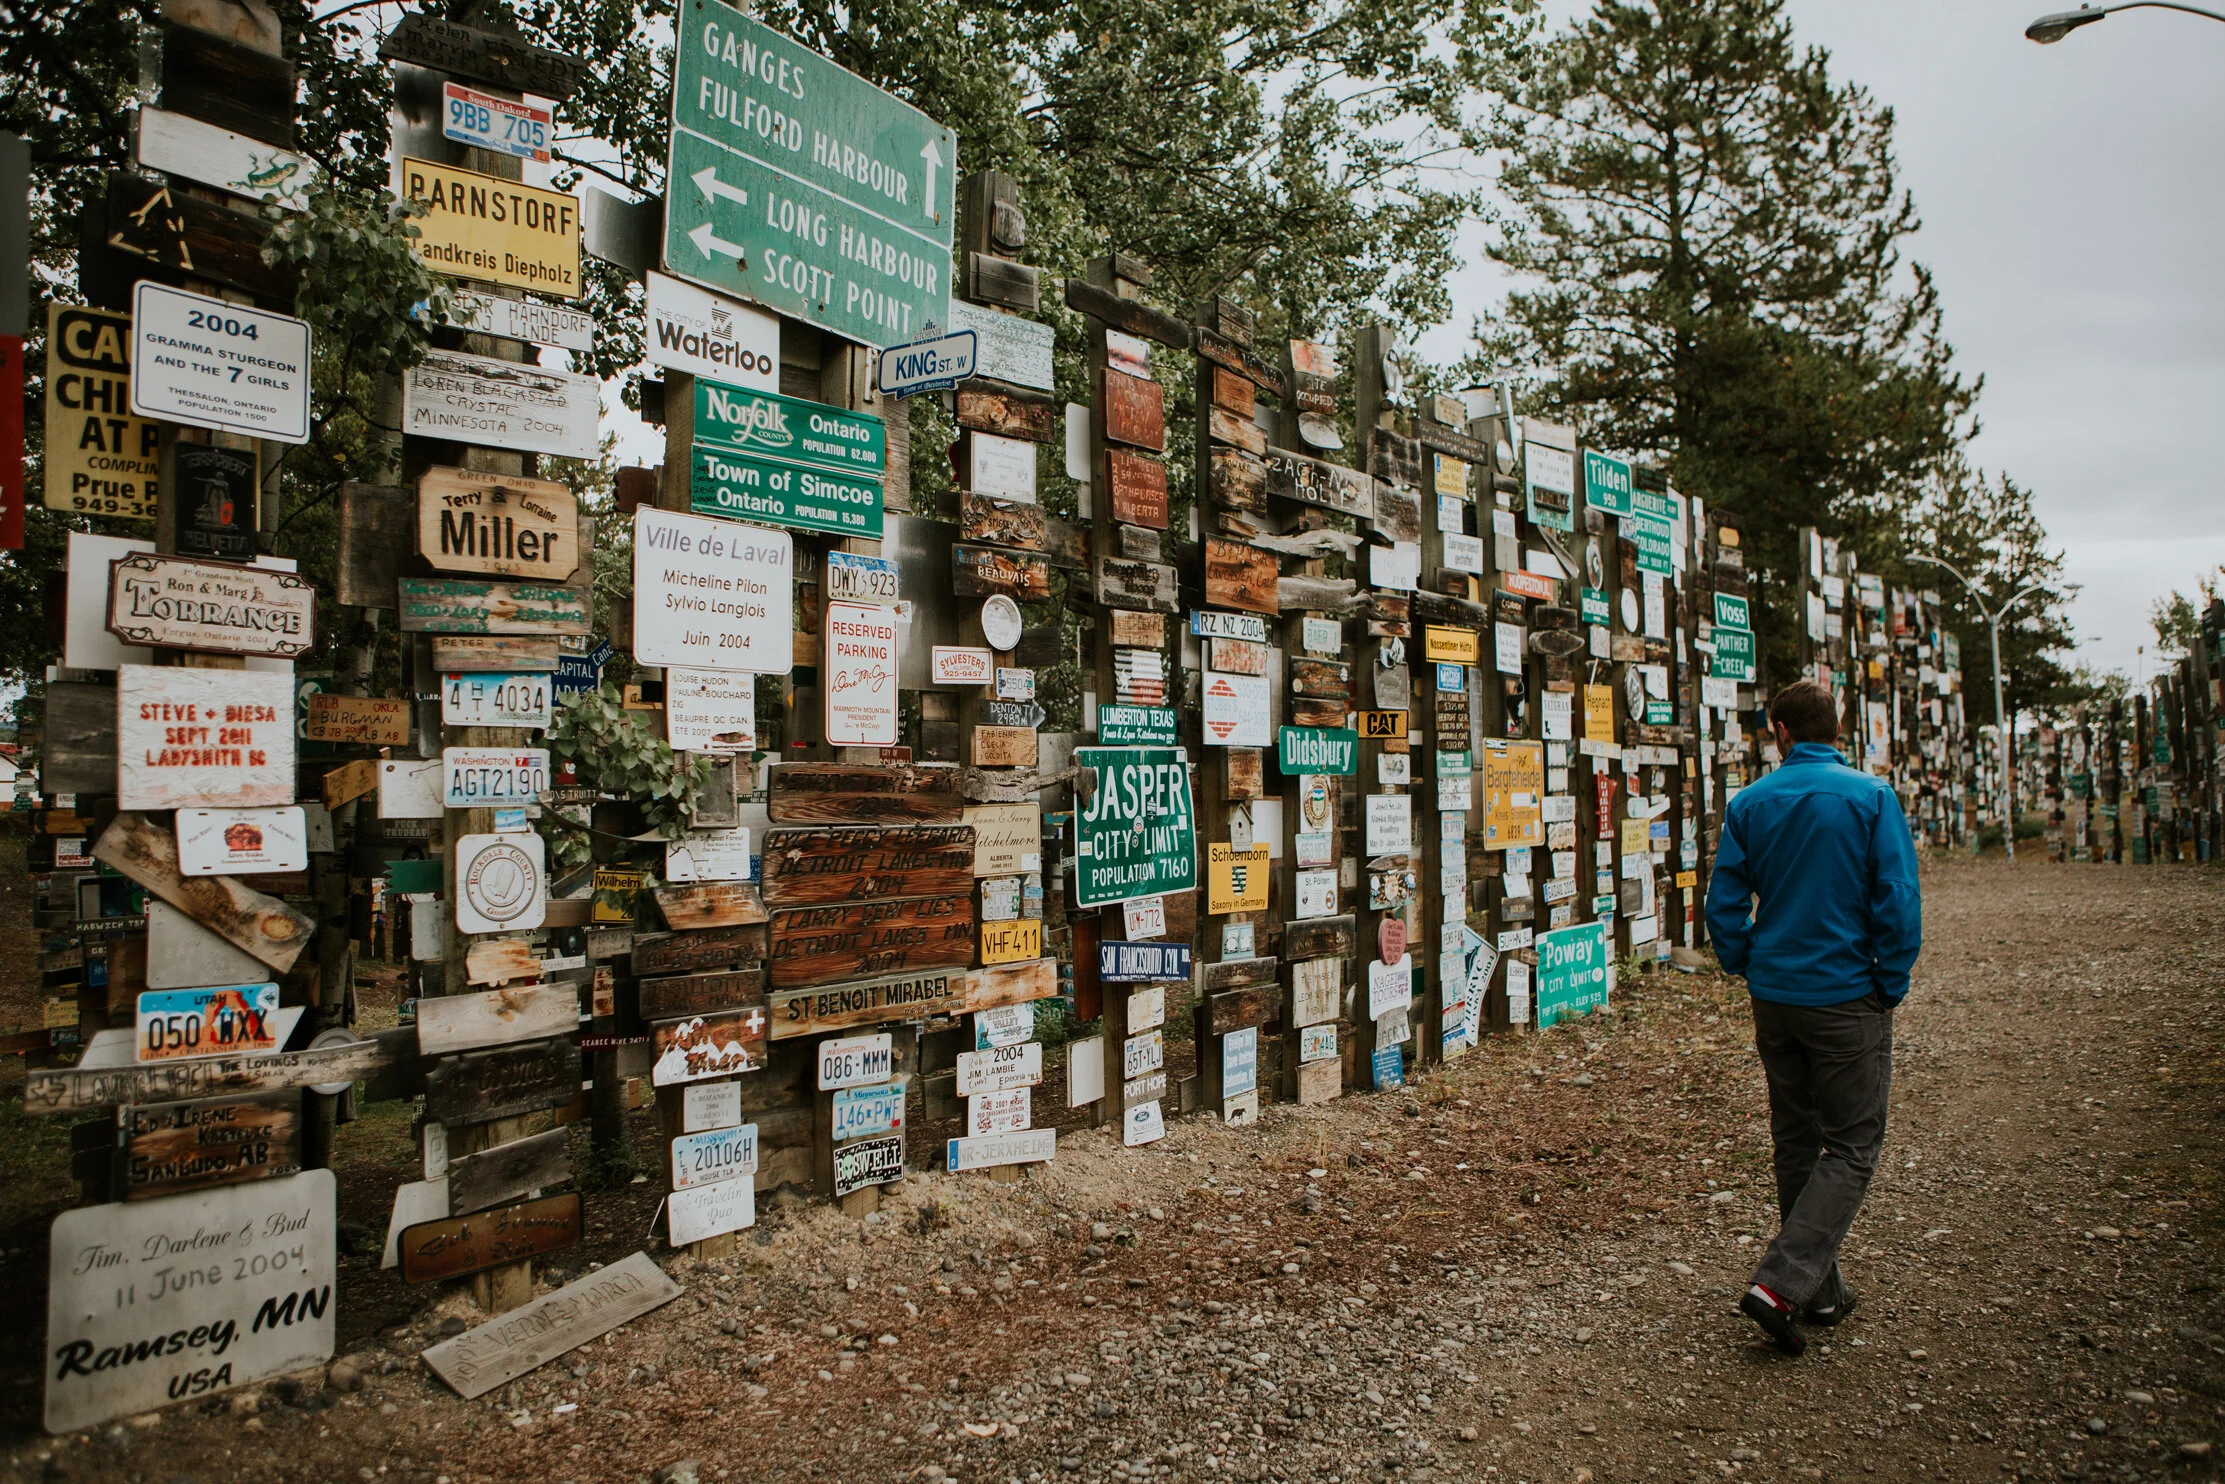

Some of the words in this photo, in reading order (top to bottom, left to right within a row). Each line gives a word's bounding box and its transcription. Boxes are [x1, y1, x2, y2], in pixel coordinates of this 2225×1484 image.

[704, 22, 805, 99] GANGES
[468, 94, 495, 112] South
[496, 102, 531, 118] Dakota
[504, 115, 544, 147] 705
[699, 76, 802, 151] FULFORD
[812, 131, 907, 206] HARBOUR
[767, 192, 826, 247] LONG
[840, 224, 937, 296] HARBOUR
[505, 252, 572, 285] Diepholz
[764, 248, 834, 305] SCOTT
[846, 281, 912, 334] POINT
[188, 310, 259, 341] 2004
[508, 302, 589, 333] HAHNDORF
[656, 307, 673, 320] THE
[509, 320, 560, 344] LINDE
[146, 333, 213, 356] GRAMMA
[218, 348, 297, 374] STURGEON
[655, 318, 773, 376] Waterloo
[154, 354, 186, 369] AND
[192, 362, 221, 377] THE
[227, 365, 244, 383] 7
[247, 374, 290, 390] GIRLS
[895, 349, 937, 381] KING
[956, 355, 967, 369] W
[1306, 377, 1327, 390] SITE
[178, 399, 242, 417] POPULATION
[245, 412, 267, 422] 1500
[234, 400, 277, 414] ONTARIO
[1296, 390, 1333, 407] OCCUPIED
[704, 387, 789, 443] Norfolk
[809, 414, 871, 443] Ontario
[80, 416, 128, 453] AT
[758, 430, 787, 442] COUNTY
[803, 438, 846, 457] POPULATION
[72, 472, 136, 499] Prue
[458, 471, 498, 484] GREEN
[507, 477, 537, 490] OHIO
[703, 455, 760, 487] Town
[769, 470, 791, 492] of
[800, 473, 874, 506] Simcoe
[1589, 459, 1628, 493] Tilden
[442, 490, 483, 508] Terry
[519, 493, 558, 524] Lorraine
[717, 487, 785, 515] Ontario
[795, 504, 838, 522] POPULATION
[1122, 501, 1159, 518] ALBERTA
[1603, 491, 1617, 508] 950
[440, 509, 559, 563] Miller
[1636, 513, 1670, 539] BERTHOUD
[646, 524, 691, 552] Ville
[699, 535, 724, 557] de
[731, 538, 786, 566] Laval
[1636, 533, 1670, 557] COLORADO
[663, 568, 732, 592] Micheline
[736, 578, 768, 596] Pilon
[832, 566, 859, 592] DWY
[870, 571, 895, 597] 923
[977, 566, 1031, 587] BEAUVAIS
[167, 577, 194, 592] Ron
[199, 582, 211, 594] &
[216, 583, 248, 601] Marg
[125, 578, 302, 635] TORRANCE
[665, 593, 707, 613] Sylvio
[710, 595, 766, 620] Langlois
[1718, 598, 1746, 625] Voss
[204, 630, 241, 642] Ontario
[832, 621, 892, 640] RESERVED
[1200, 616, 1217, 633] RZ
[1223, 617, 1236, 635] NZ
[1241, 619, 1264, 637] 2004
[682, 630, 710, 646] Juin
[719, 633, 751, 650] 2004
[837, 643, 888, 660] PARKING
[1715, 632, 1749, 653] PANTHER
[940, 653, 986, 672] SYLVESTERS
[1720, 656, 1745, 675] CREEK
[672, 673, 699, 684] LOUISE
[701, 676, 729, 686] HUDON
[494, 684, 544, 713] 4034
[705, 689, 751, 700] BOUCHARD
[140, 703, 198, 722] STEVE
[675, 714, 709, 723] BEAUPRE
[833, 705, 861, 714] MAMMOTH
[862, 706, 891, 714] MOUNTAIN
[1101, 707, 1149, 727] LUMBERTON
[1150, 709, 1174, 728] TEXAS
[692, 727, 712, 736] 2007
[981, 730, 1017, 738] FABIENNE
[1367, 713, 1399, 735] CAT
[453, 757, 511, 766] WASHINGTON
[1286, 730, 1352, 772] Didsbury
[452, 768, 544, 797] AGT2190
[1487, 763, 1541, 794] Bargteheide
[1082, 764, 1187, 822] JASPER
[1494, 809, 1508, 820] Kreis
[726, 834, 744, 842] Forest
[1094, 828, 1132, 861] CITY
[1144, 824, 1179, 856] LIMIT
[779, 852, 870, 876] DETROIT
[990, 854, 1013, 862] ALBERTA
[1092, 861, 1155, 888] POPULATION
[1159, 856, 1189, 879] 7160
[1211, 902, 1233, 911] Saxony
[1234, 900, 1240, 908] in
[1240, 899, 1266, 908] Germany
[773, 932, 863, 960] DETROIT
[870, 927, 929, 949] LAKES
[1546, 938, 1593, 969] Poway
[1101, 945, 1116, 975] SAN
[1120, 945, 1161, 975] FRANCISQUITO
[1549, 978, 1564, 993] CITY
[1570, 969, 1591, 988] LIMIT
[194, 993, 227, 1005] UTAH
[1373, 985, 1398, 1002] TOURS
[1542, 1004, 1552, 1018] POP
[1575, 993, 1588, 1007] ELEV
[1590, 991, 1602, 1001] 525
[993, 1017, 1019, 1029] VALLEY
[179, 1044, 239, 1056] CENTENNIAL
[993, 1045, 1024, 1063] 2004
[967, 1070, 984, 1080] JIM
[985, 1065, 1016, 1076] LAMBIE
[853, 1089, 889, 1099] Minnesota
[1124, 1078, 1148, 1099] PORT
[1148, 1072, 1166, 1094] HOPE
[995, 1100, 1008, 1109] 2001
[837, 1105, 864, 1130] 146
[235, 1142, 270, 1167] AB
[695, 1137, 752, 1172] 20106H
[141, 1227, 232, 1263] Darlene
[263, 1208, 312, 1238] Bud
[148, 1263, 224, 1300] June
[233, 1244, 306, 1281] 2004
[55, 1319, 241, 1381] Ramsey,
[251, 1284, 331, 1333] MN
[167, 1362, 233, 1400] USA
